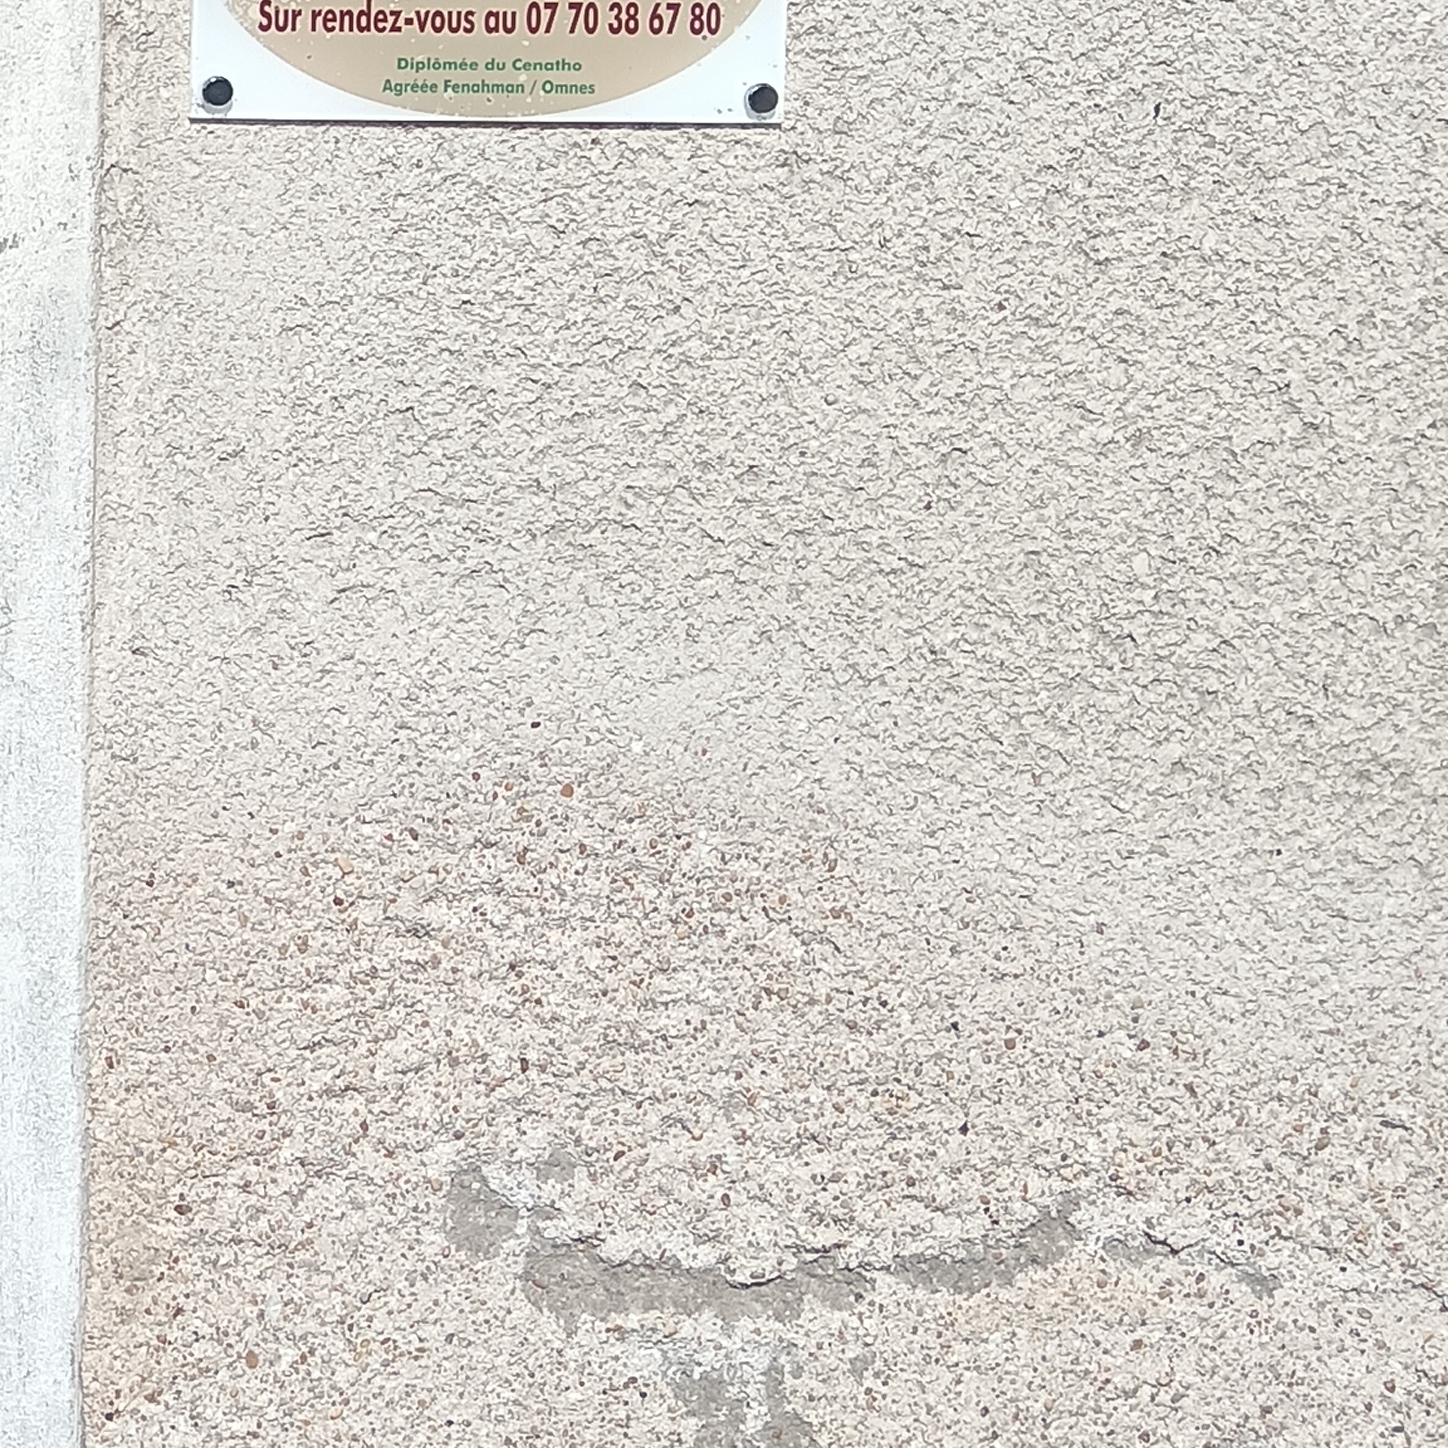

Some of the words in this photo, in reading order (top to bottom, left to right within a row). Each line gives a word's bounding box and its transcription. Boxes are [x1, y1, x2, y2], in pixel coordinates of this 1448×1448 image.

[484, 10, 517, 35] au
[526, 1, 557, 35] 07
[567, 1, 599, 35] 70
[607, 1, 639, 35] 38
[649, 2, 682, 36] 67
[689, 2, 721, 36] 80
[397, 57, 480, 74] Diplômée
[484, 57, 507, 71] du
[511, 58, 582, 72] Cenatho
[382, 78, 439, 97] Agréée
[443, 79, 525, 94] Fenahman
[541, 79, 595, 95] Omnes
